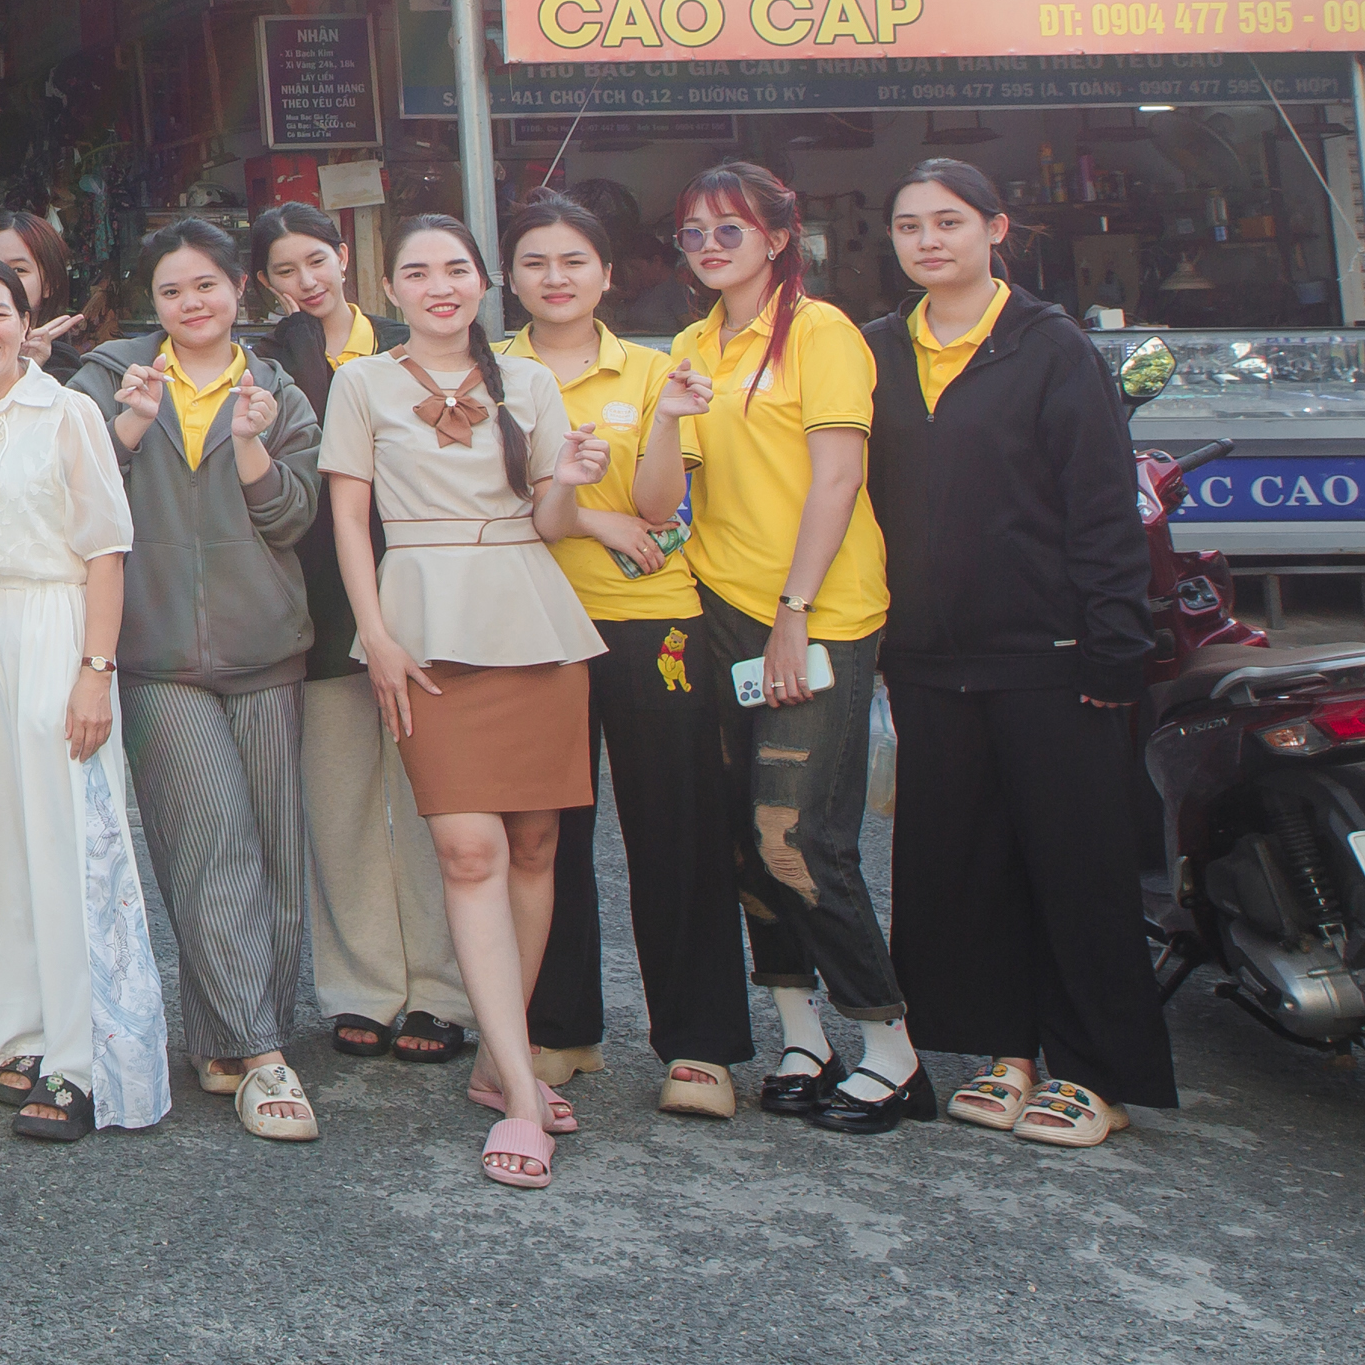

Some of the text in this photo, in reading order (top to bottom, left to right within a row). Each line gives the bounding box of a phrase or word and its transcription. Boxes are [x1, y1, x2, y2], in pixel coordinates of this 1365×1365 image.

[1039, 0, 1365, 36] ĐT: 0904 477 595 09
[297, 25, 339, 46] NHẬN
[550, 87, 587, 108] CHỢ
[591, 89, 627, 104] TCH
[632, 89, 672, 106] Q.12
[688, 84, 749, 103] ĐƯỜNG
[878, 84, 906, 100] ĐT:
[912, 84, 957, 99] 0904
[962, 83, 994, 98] 477
[1001, 82, 1034, 97] 595
[1139, 80, 1182, 95] 0907
[1189, 79, 1220, 94] 477
[1226, 79, 1262, 94] 595
[282, 99, 309, 109] THEO
[1250, 475, 1359, 506] CAO
[1178, 715, 1232, 737] VISION
